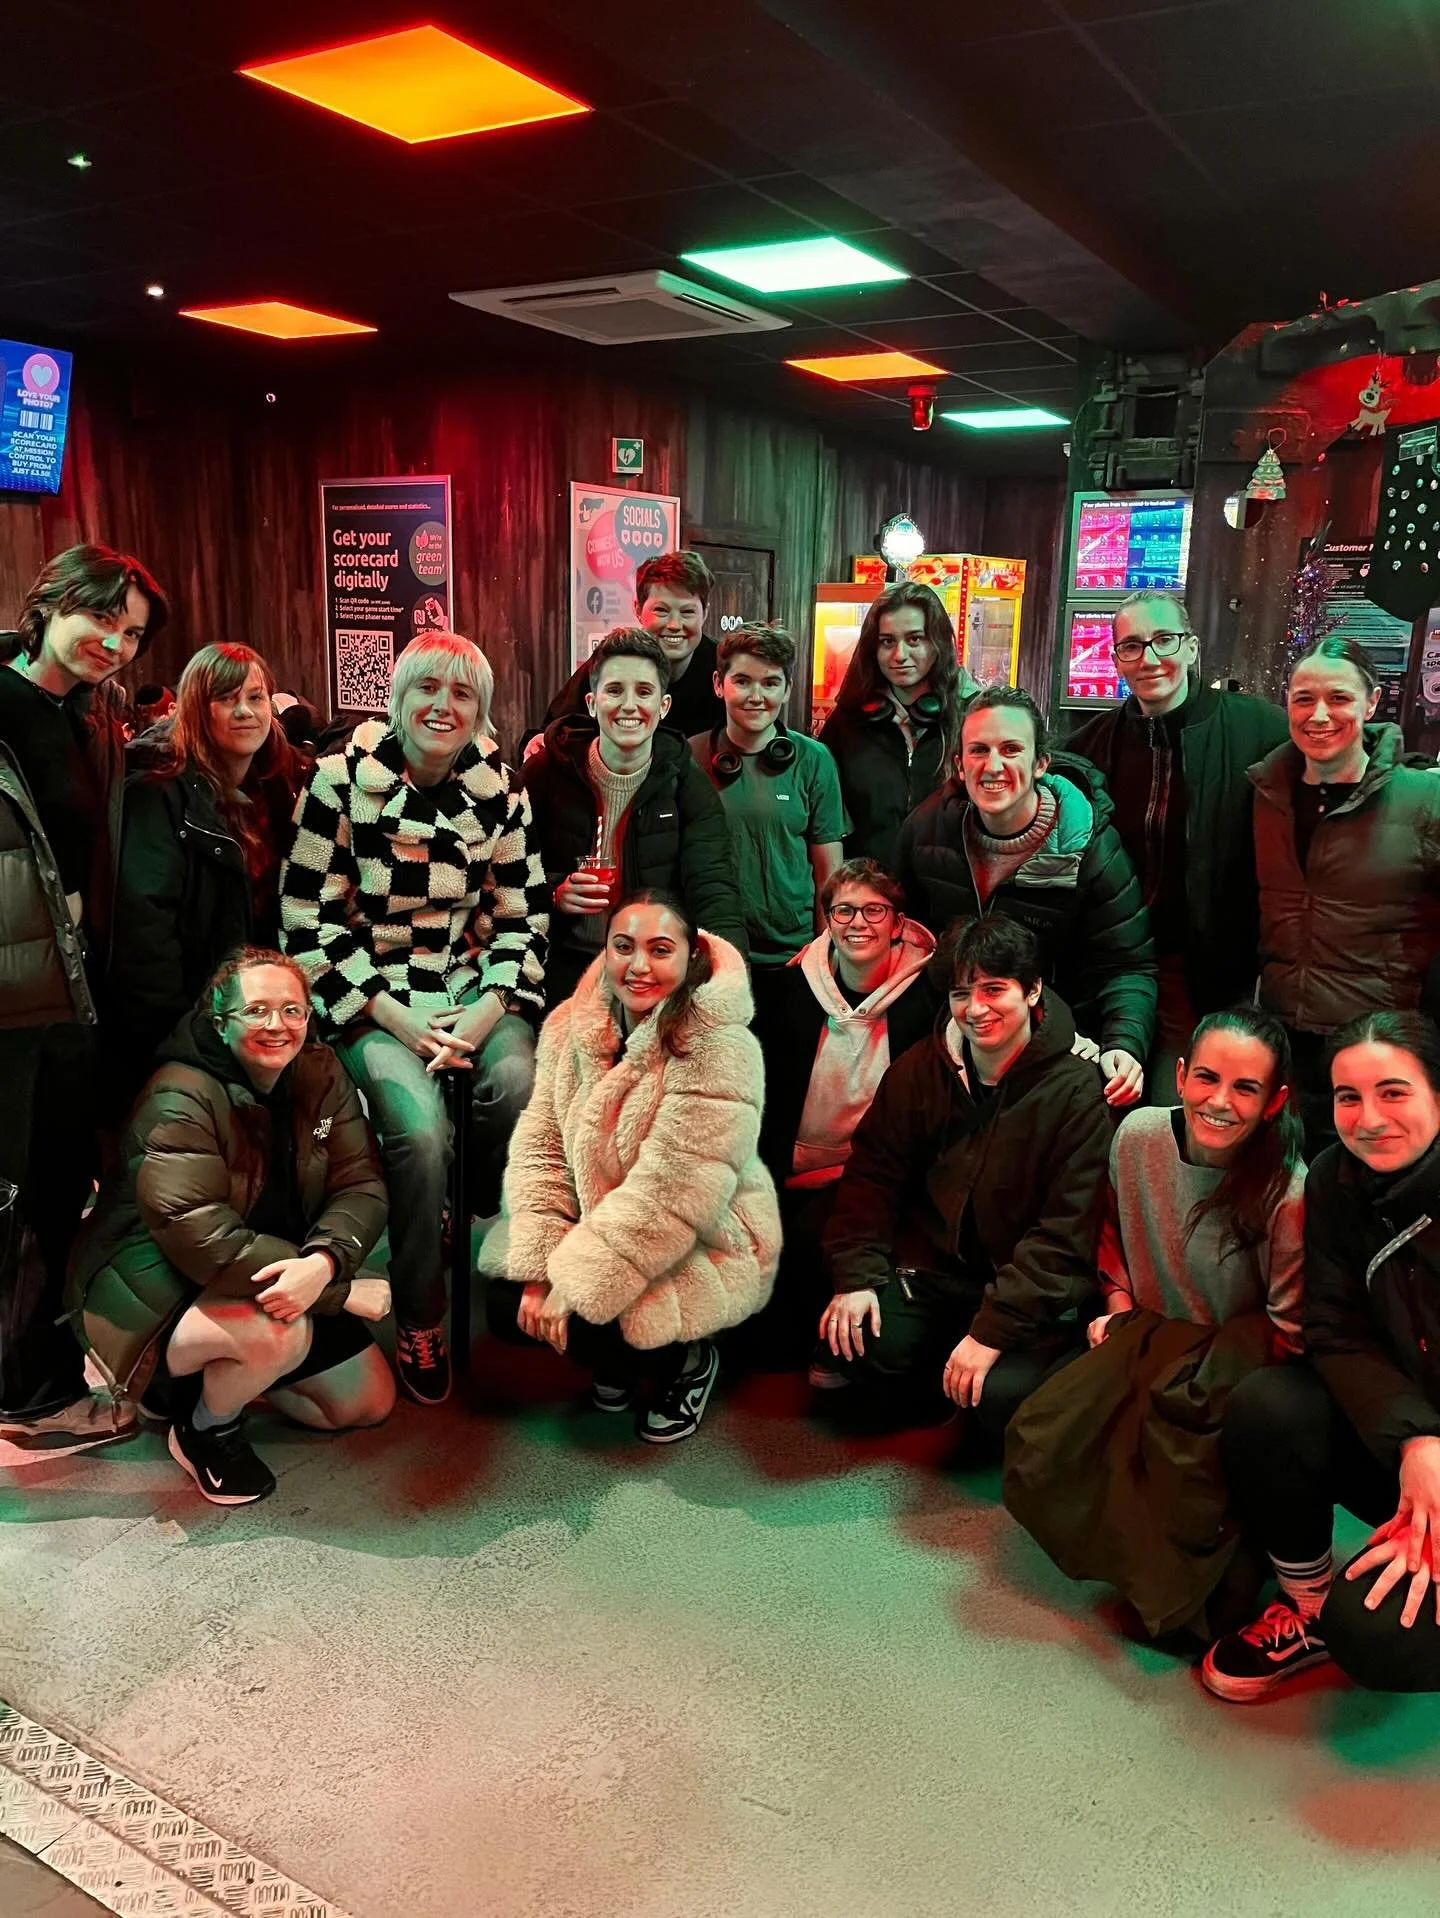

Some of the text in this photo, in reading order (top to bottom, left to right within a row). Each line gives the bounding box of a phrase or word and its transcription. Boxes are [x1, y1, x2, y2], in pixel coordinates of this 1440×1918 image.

[17, 389, 60, 403] LOVE YOUR
[12, 430, 56, 443] SCAN YOUR
[10, 437, 58, 450] SCORECARD
[9, 452, 57, 464] CONTROL TO
[24, 447, 54, 457] MISSION
[11, 467, 30, 475] JUST
[12, 460, 52, 471] BUY FROM
[623, 505, 661, 529] SOCIALS
[333, 529, 392, 549] Get your
[1323, 543, 1368, 552] Customer
[333, 549, 399, 567] scorecard
[415, 552, 442, 564] green
[610, 548, 625, 569] US
[334, 569, 389, 592] digitally
[350, 597, 357, 605] QR
[339, 604, 354, 612] Select
